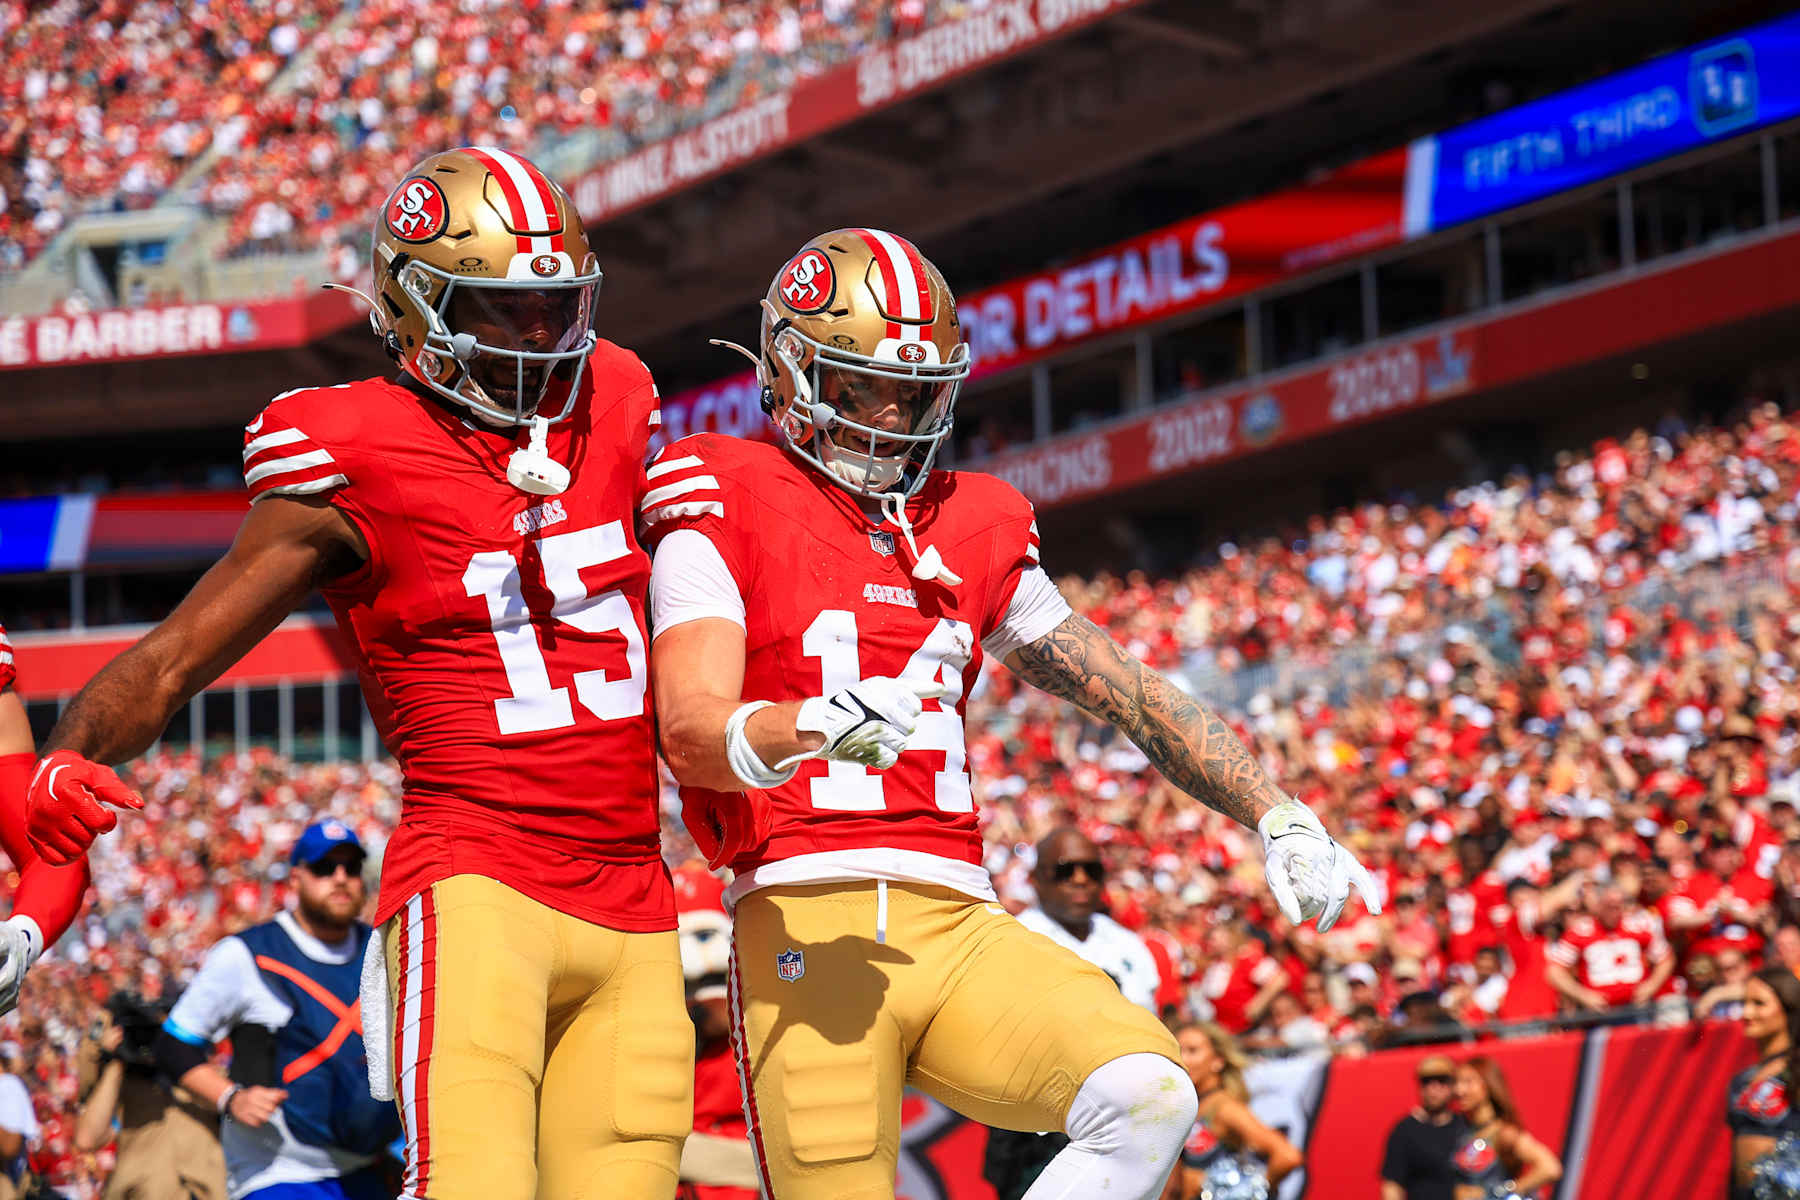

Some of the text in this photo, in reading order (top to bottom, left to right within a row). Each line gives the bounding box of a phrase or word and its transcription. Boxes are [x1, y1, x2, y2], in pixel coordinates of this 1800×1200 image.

[897, 2, 1037, 91] DERRICK
[670, 92, 790, 179] ALSTOTT
[1462, 126, 1565, 193] FIFTH
[1570, 85, 1683, 159] THIRD
[1022, 220, 1230, 349] DETAILS
[36, 304, 222, 363] BARBER
[461, 519, 648, 736] 15
[862, 583, 919, 609] 49ERS
[802, 608, 975, 814] 14
[781, 962, 801, 977] NFL
